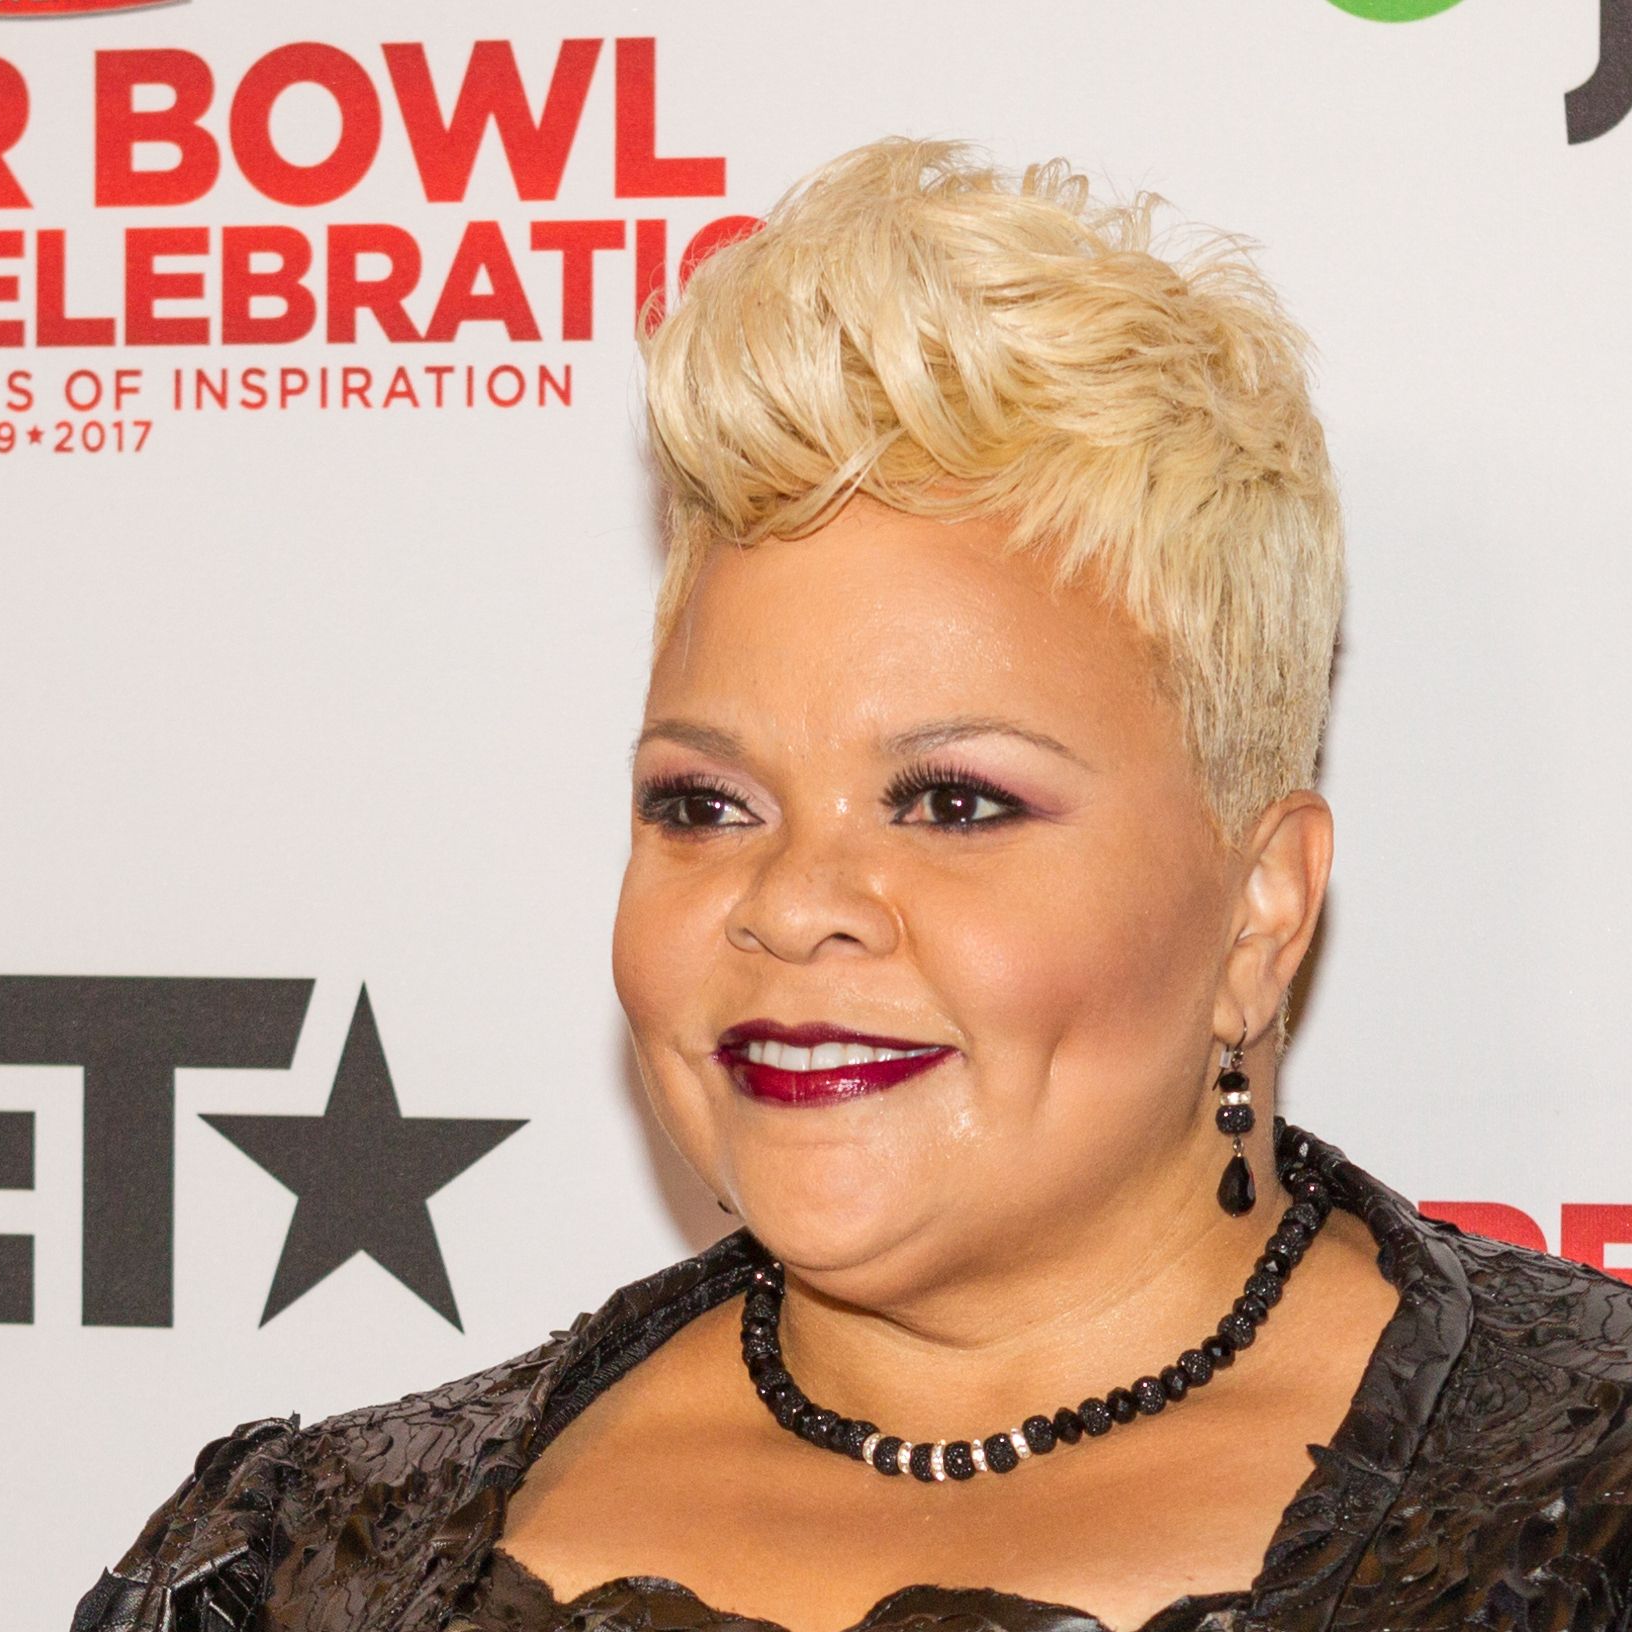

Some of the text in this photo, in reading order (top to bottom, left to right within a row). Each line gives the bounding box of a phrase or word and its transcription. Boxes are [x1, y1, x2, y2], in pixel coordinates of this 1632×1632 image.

[94, 37, 726, 208] BOWL
[65, 369, 142, 412] OF
[174, 364, 571, 410] INSPIRATION
